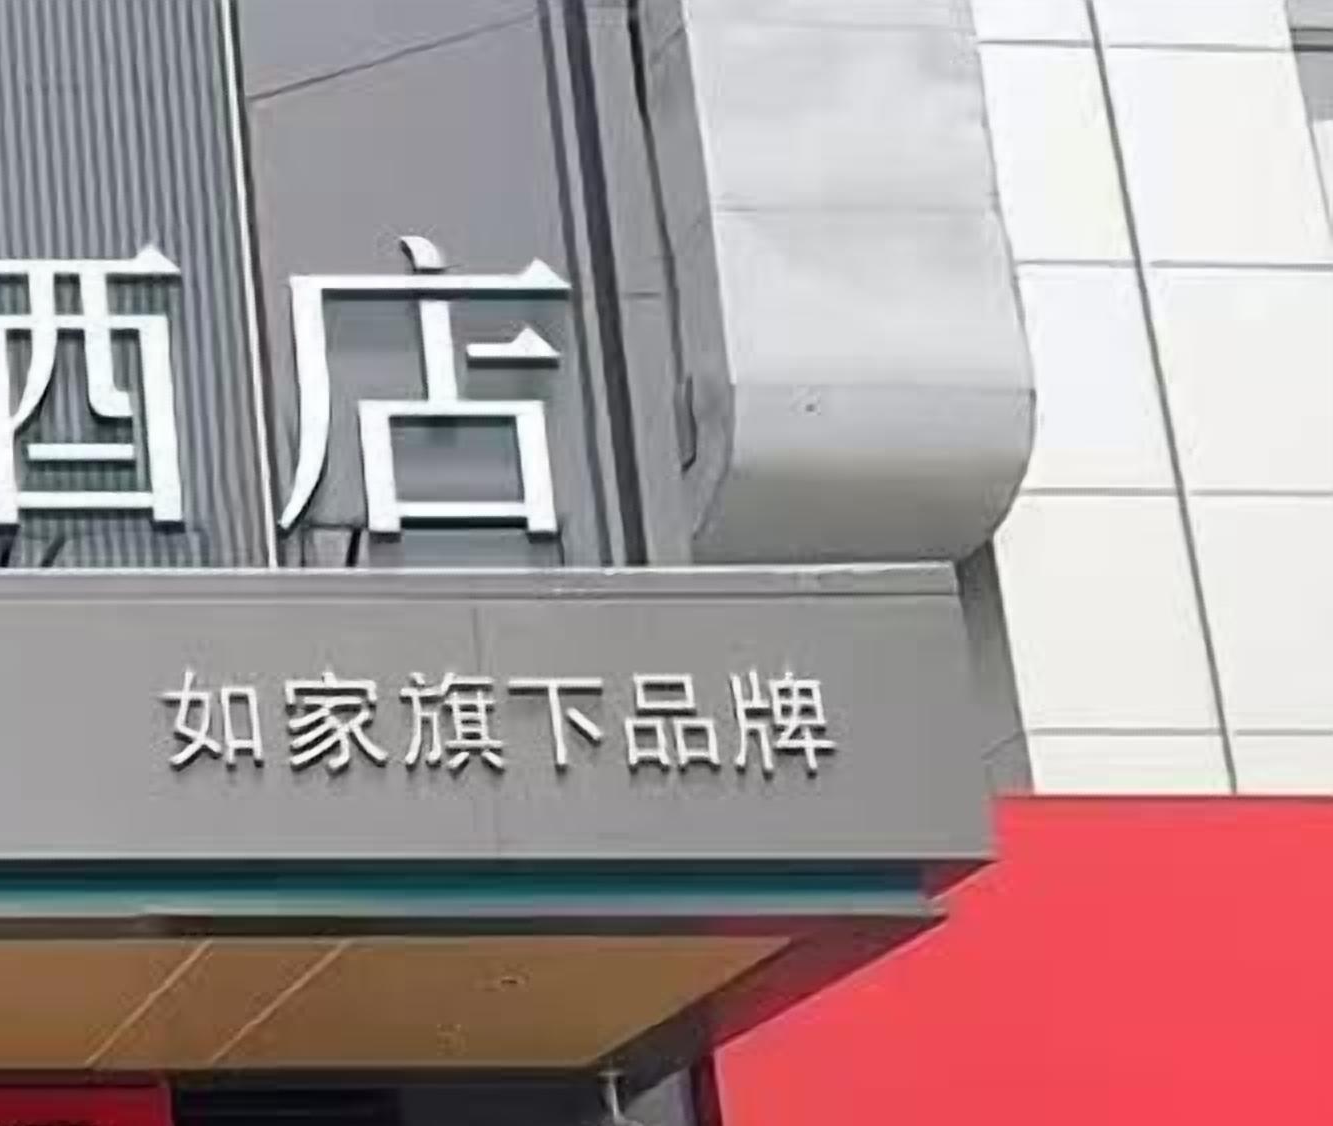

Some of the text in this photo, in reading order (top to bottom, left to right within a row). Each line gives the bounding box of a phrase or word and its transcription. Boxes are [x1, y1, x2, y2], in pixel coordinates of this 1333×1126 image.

[158, 671, 838, 779] 如家旗下品牌
